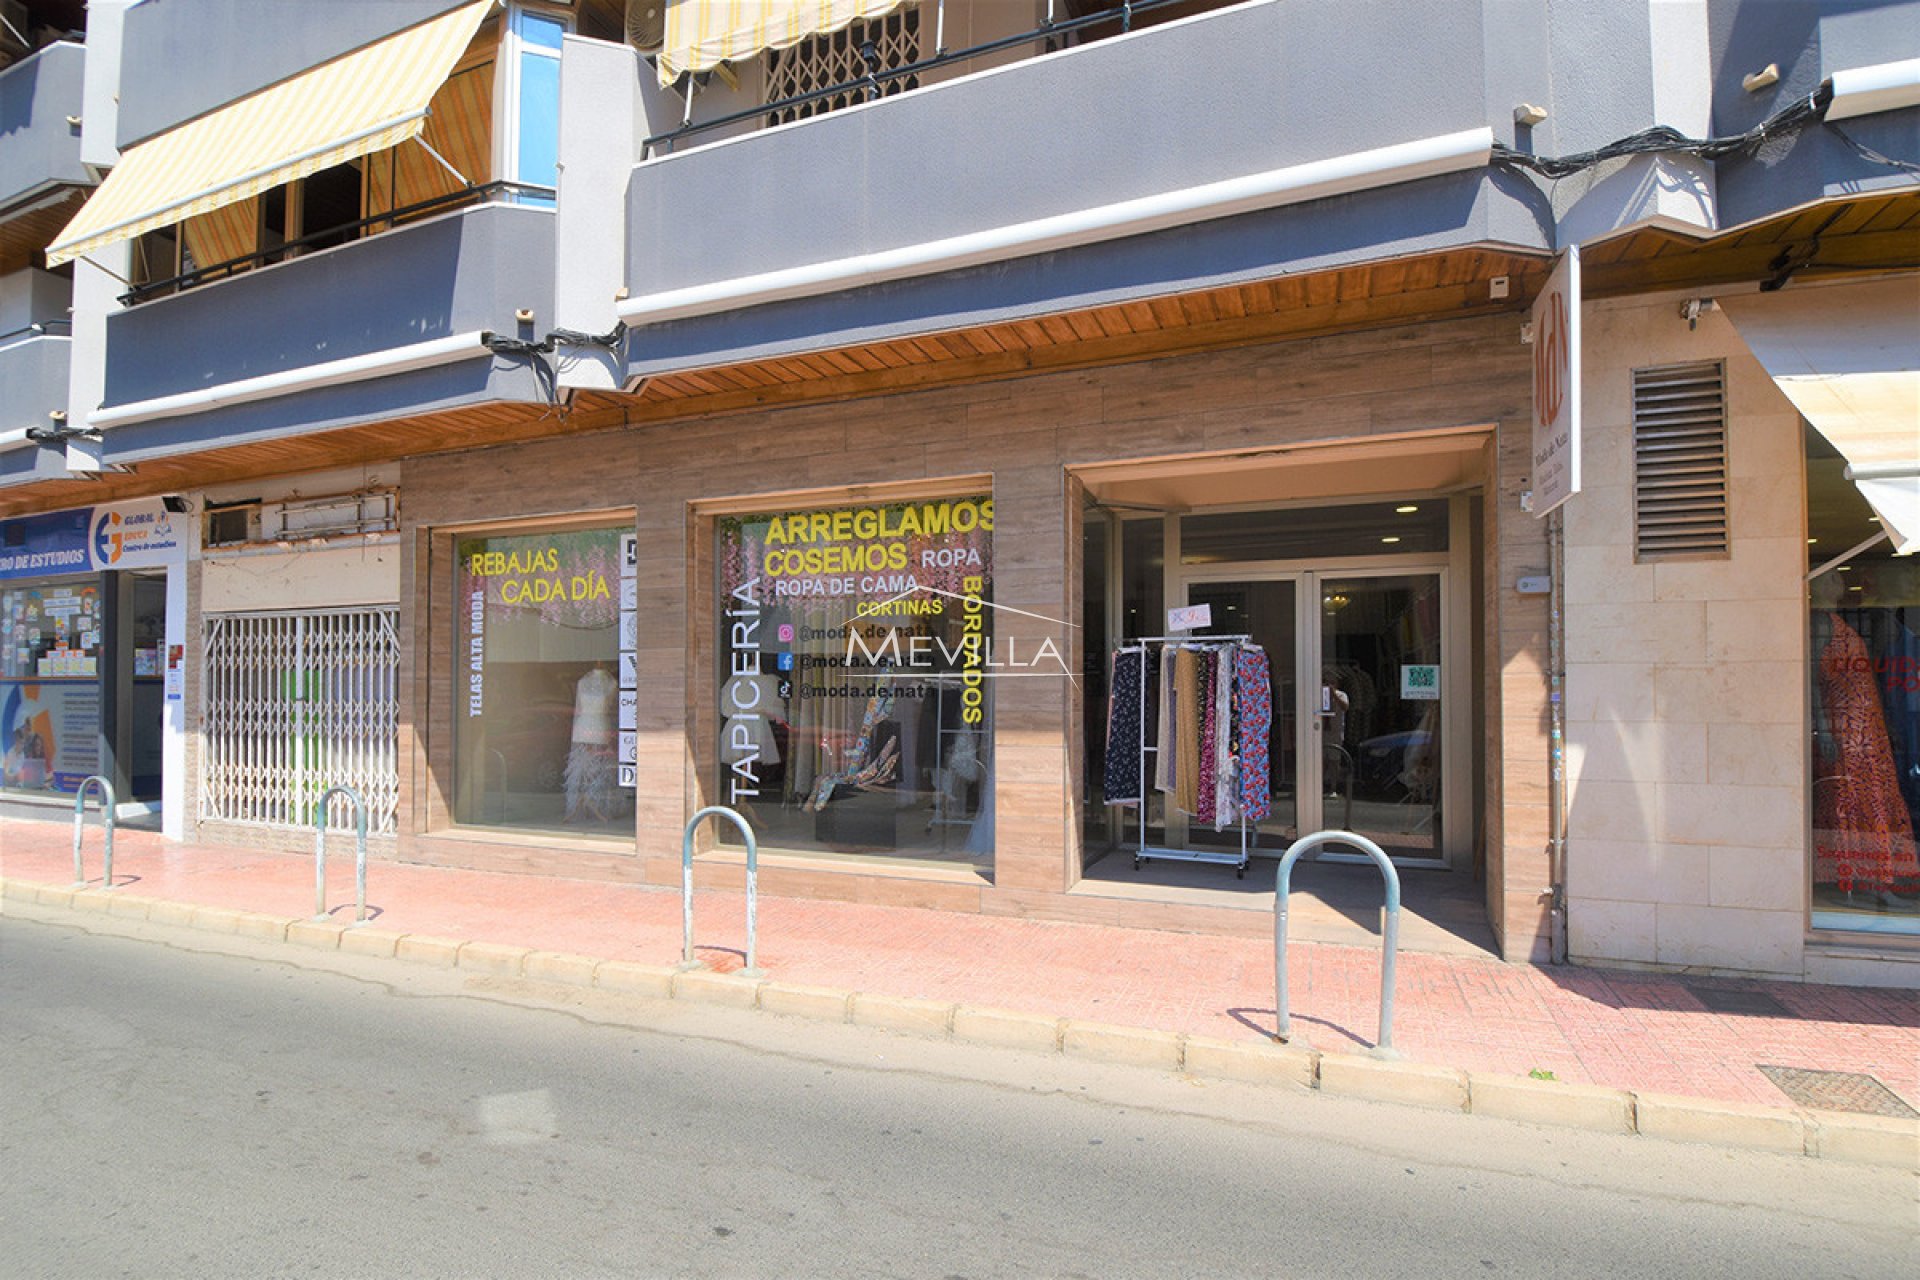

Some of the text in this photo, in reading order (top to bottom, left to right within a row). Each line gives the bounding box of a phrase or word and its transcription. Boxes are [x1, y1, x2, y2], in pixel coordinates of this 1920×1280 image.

[764, 500, 993, 545] ARREGLAMOS
[15, 553, 30, 570] DE
[30, 549, 85, 568] ESTUDIOS
[471, 548, 558, 576] REBAJAS
[764, 543, 982, 577] COSEMOS ROPA
[501, 569, 611, 604] CADA DÍA
[775, 574, 919, 597] ROPA DE CAMA
[856, 599, 943, 617] CORTINAS
[470, 591, 484, 717] TELAS ALTA MODA
[962, 576, 983, 724] BORDADOS
[725, 576, 761, 805] TAPICERÍA
